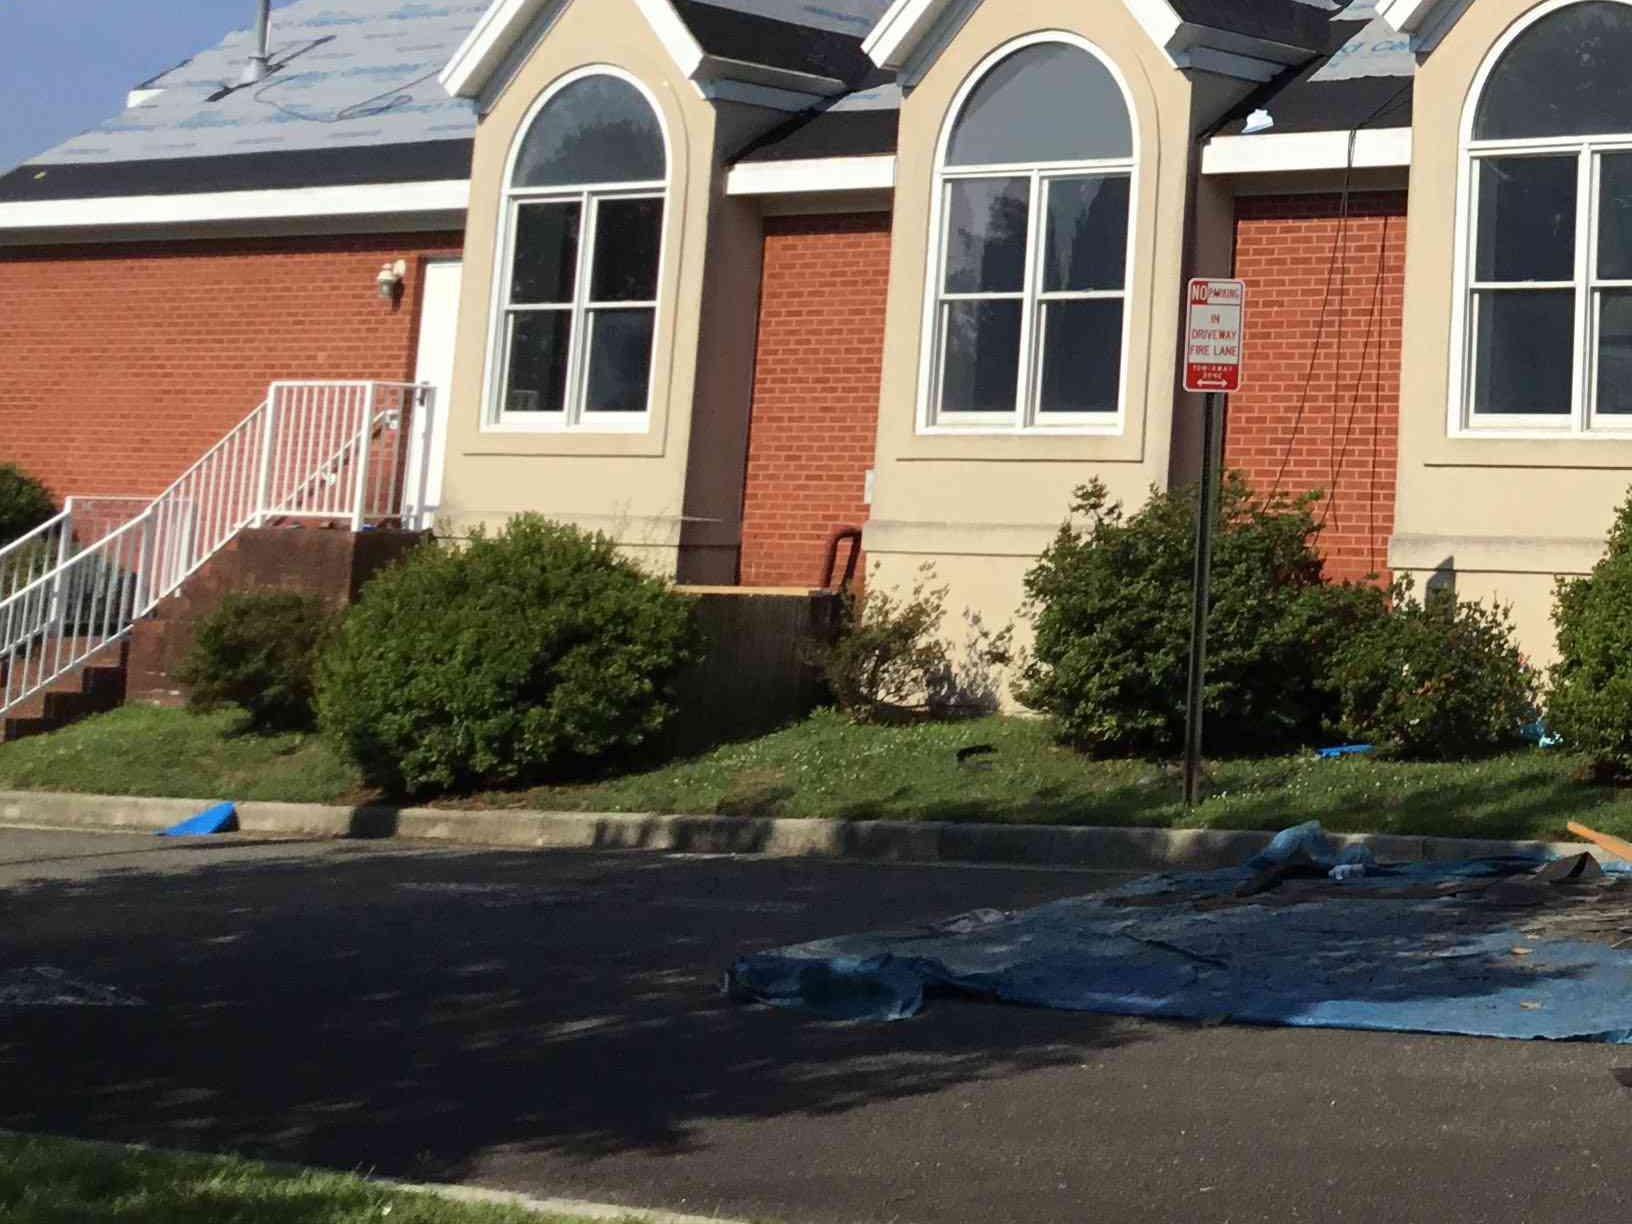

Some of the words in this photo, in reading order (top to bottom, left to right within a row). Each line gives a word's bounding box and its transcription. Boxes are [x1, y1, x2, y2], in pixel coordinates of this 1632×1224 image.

[1191, 284, 1208, 301] NO
[1210, 312, 1221, 325] IN
[1191, 328, 1237, 340] DRIVEWAY
[1190, 344, 1209, 356] FIRE
[1213, 344, 1237, 356] LANE
